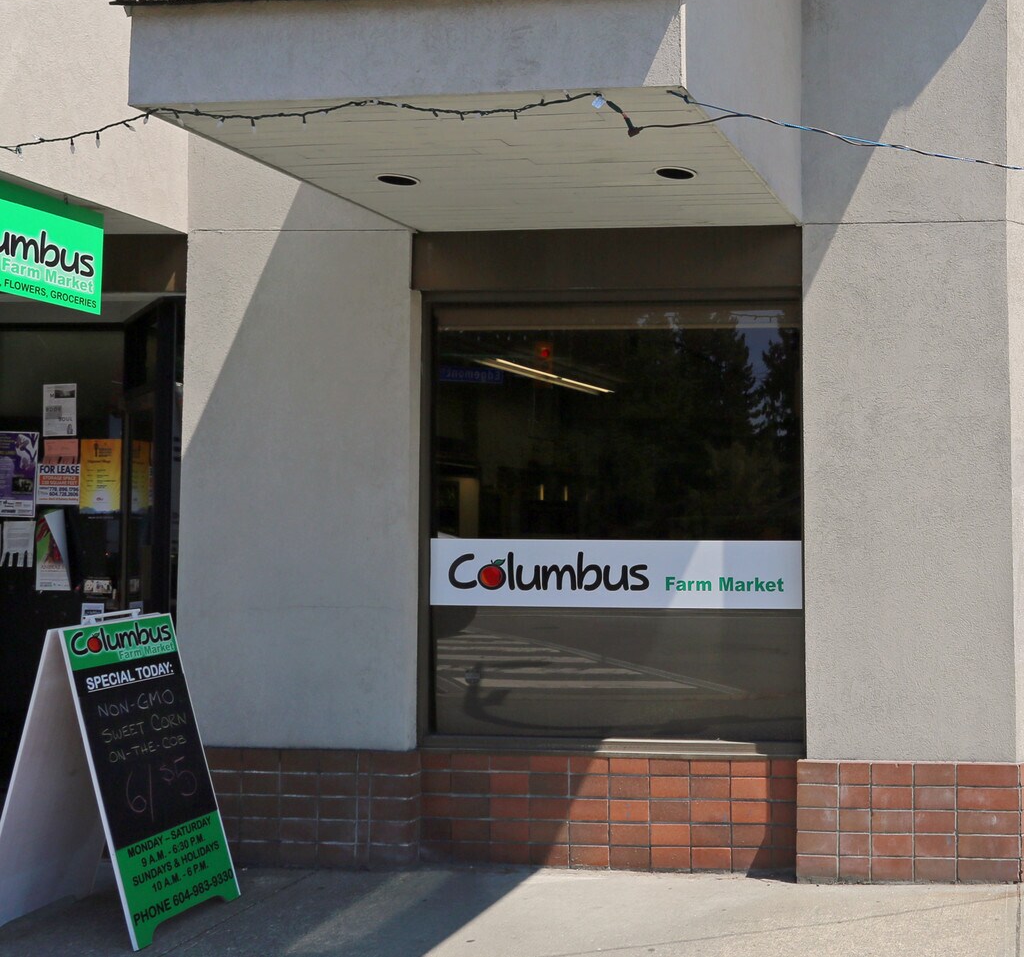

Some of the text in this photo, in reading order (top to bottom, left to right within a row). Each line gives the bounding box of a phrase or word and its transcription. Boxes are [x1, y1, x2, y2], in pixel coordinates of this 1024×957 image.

[2, 258, 94, 292] Farm Market
[4, 279, 97, 308] FLOWERS, GROCERIES
[40, 466, 79, 474] FOR LEASE
[448, 551, 784, 593] Columbus Farm Market
[71, 623, 171, 655] Columbus
[120, 644, 175, 660] Farm Market
[86, 662, 173, 690] SPECIAL TODAY:
[98, 689, 174, 717] NON-GMO
[102, 712, 186, 743] SWEET CORN
[109, 735, 186, 763] ON-THE-COB
[128, 836, 163, 858] MONDAY
[171, 816, 211, 840] SATURDAY
[141, 857, 148, 867] 9
[149, 851, 166, 865] A.M.
[172, 840, 189, 854] 6:30
[190, 834, 205, 843] P.M.
[132, 841, 219, 886] SUNDAYS & HOLIDAYS
[152, 881, 162, 892] 10
[164, 873, 181, 886] A.M.
[187, 867, 193, 877] 6
[194, 861, 208, 873] P.M.
[133, 868, 233, 926] PHONE 604-983-9330
